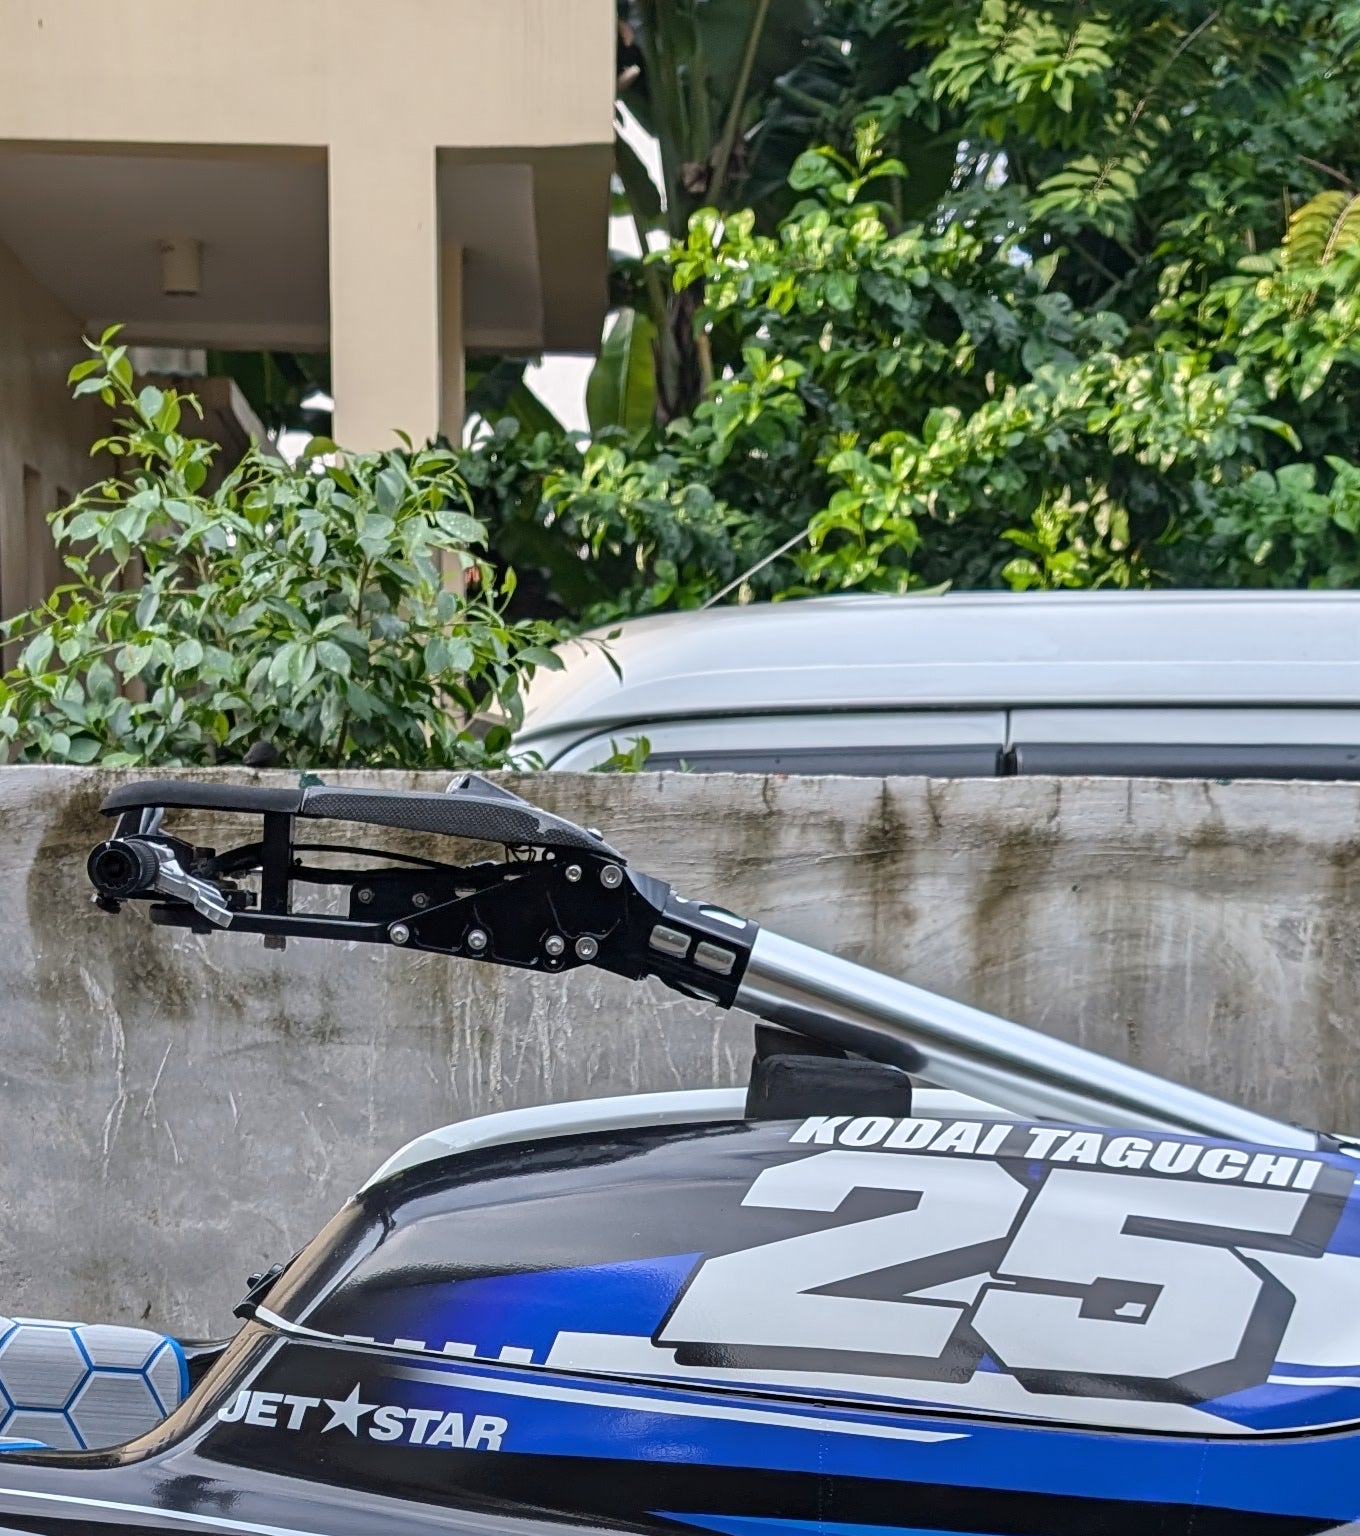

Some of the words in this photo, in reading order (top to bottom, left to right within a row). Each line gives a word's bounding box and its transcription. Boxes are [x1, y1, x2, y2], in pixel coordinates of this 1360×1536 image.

[788, 1115, 1014, 1156] KODAI
[1024, 1126, 1324, 1190] TAGUCHI
[656, 1148, 1316, 1380] 25
[217, 1390, 323, 1431] JET
[368, 1405, 509, 1451] STAR
